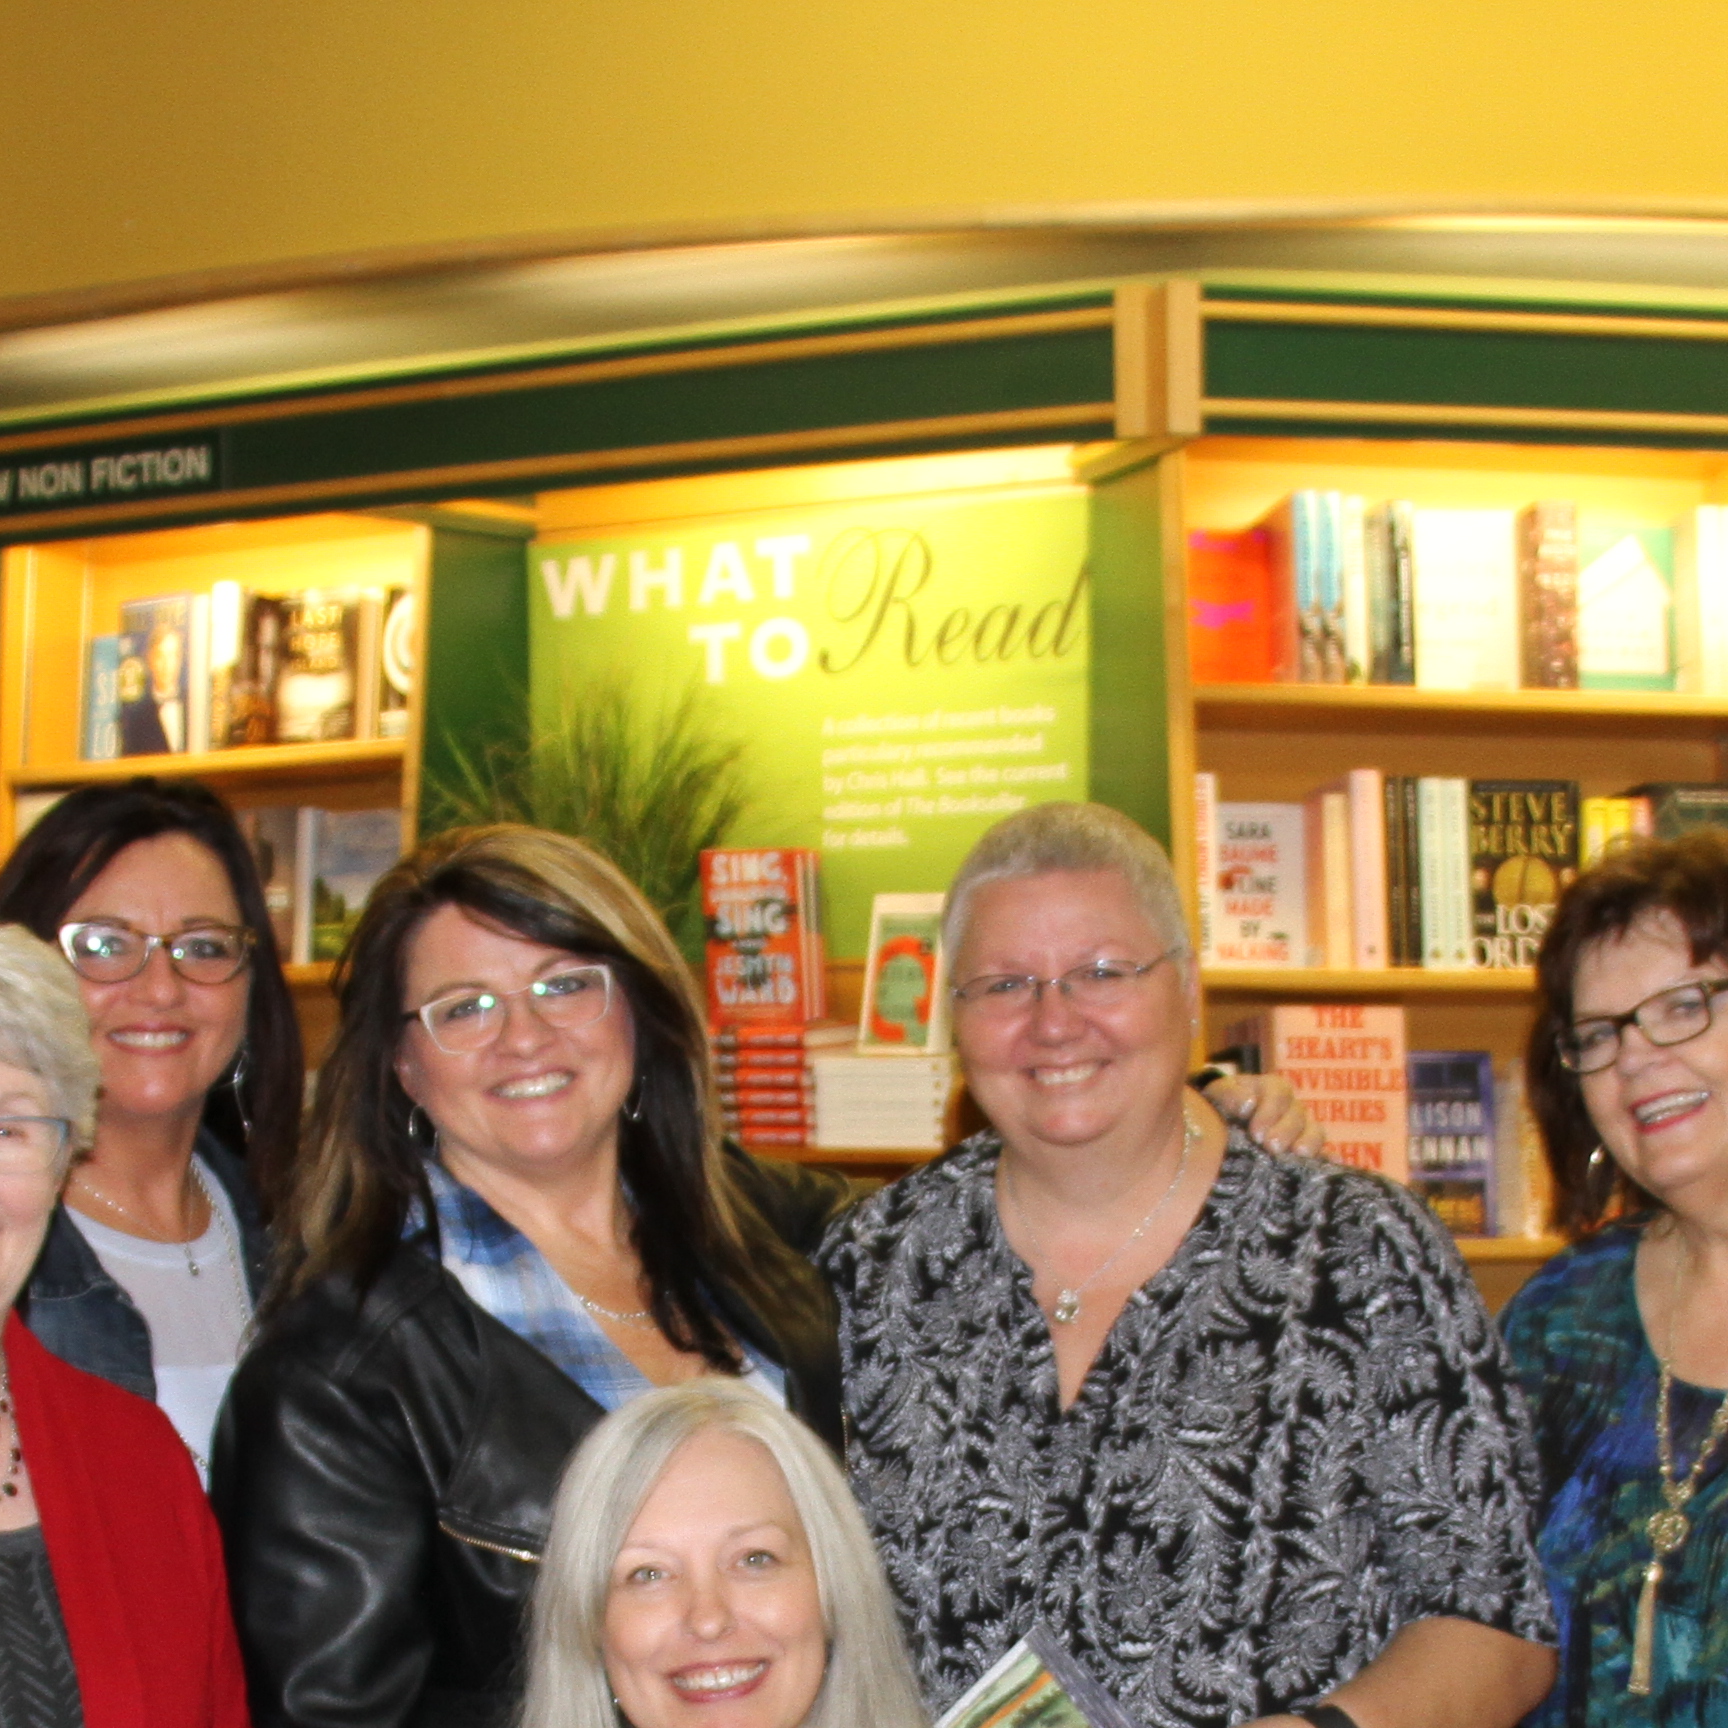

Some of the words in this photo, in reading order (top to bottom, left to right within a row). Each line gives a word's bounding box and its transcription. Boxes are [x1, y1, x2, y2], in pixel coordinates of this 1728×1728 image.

[19, 462, 83, 498] NON
[91, 446, 208, 491] FICTION
[541, 534, 811, 620] WHAT
[290, 605, 341, 626] LAST
[688, 617, 809, 685] TO
[815, 526, 1091, 675] Read
[837, 713, 919, 734] collection
[922, 710, 941, 731] of
[998, 705, 1055, 724] books
[915, 733, 1043, 757] recommended
[823, 775, 843, 795] by
[936, 766, 966, 784] See
[969, 765, 1000, 783] the
[1001, 762, 1067, 782] current
[823, 802, 881, 820] edition
[883, 797, 903, 817] of
[905, 796, 936, 815] The
[1472, 792, 1567, 823] STEVE
[823, 828, 845, 847] for
[1226, 821, 1271, 840] SARA
[1473, 823, 1571, 854] BERRY
[715, 901, 790, 935] SING
[1240, 920, 1260, 939] BY
[1313, 1005, 1364, 1029] THE
[1286, 1037, 1392, 1060] HEART'S
